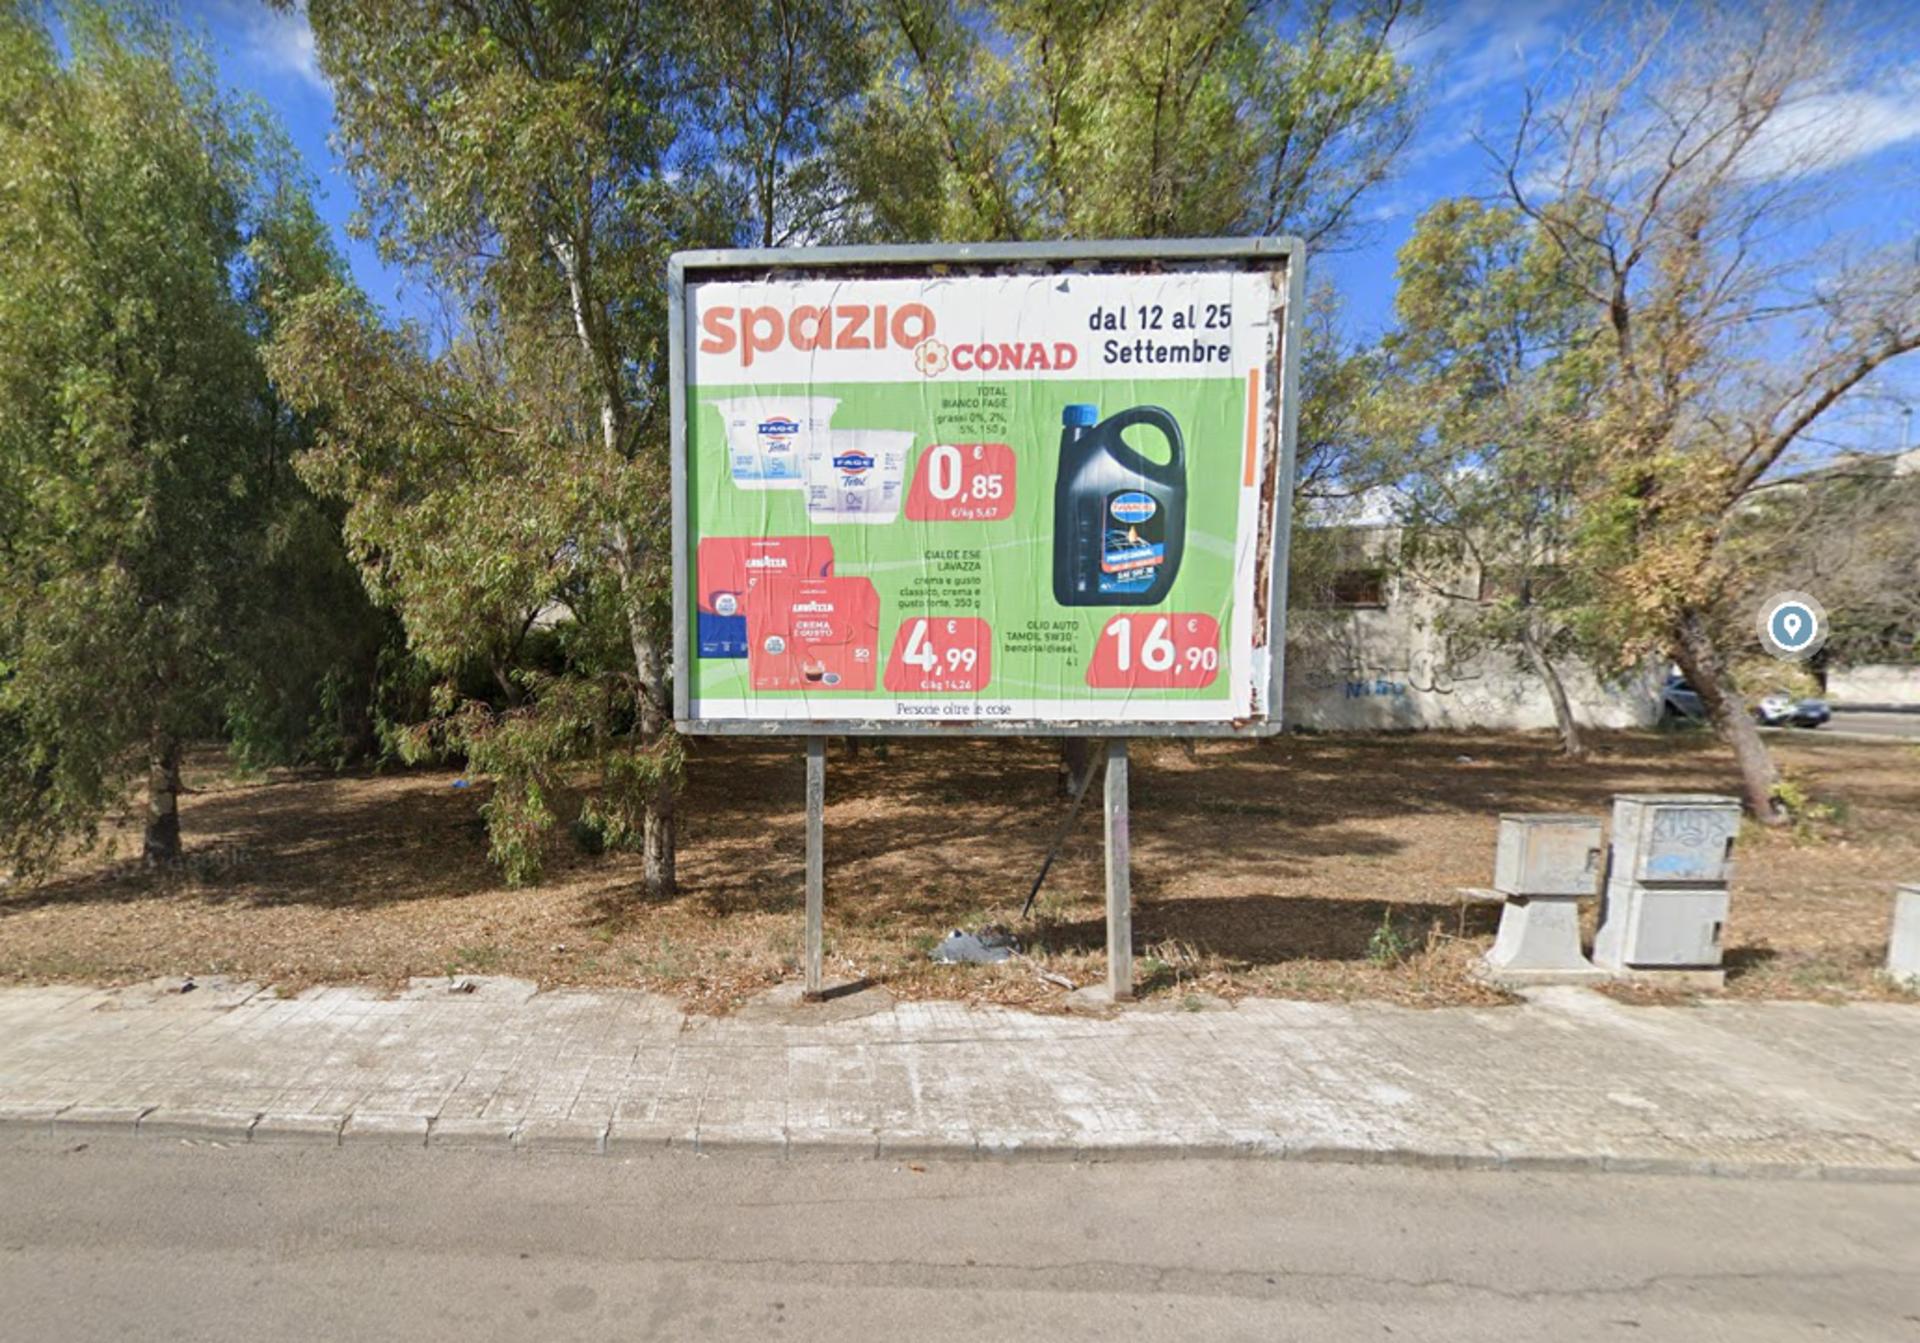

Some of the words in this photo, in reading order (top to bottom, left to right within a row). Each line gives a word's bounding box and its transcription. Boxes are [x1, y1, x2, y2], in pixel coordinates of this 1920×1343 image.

[1089, 305, 1127, 331] dal
[1137, 305, 1164, 330] 12
[1172, 304, 1197, 330] al
[1204, 303, 1232, 329] 25
[700, 302, 936, 367] spazio
[951, 342, 1079, 371] CONAD
[1104, 338, 1232, 364] Settembre
[976, 386, 1008, 396] TOTAL
[973, 446, 984, 461] €
[937, 561, 982, 571] LAVAZZA
[947, 620, 957, 635] €
[1052, 620, 1080, 631] AUTO
[1187, 618, 1198, 633] €
[896, 702, 940, 716] Persone
[985, 703, 1012, 716] cose
